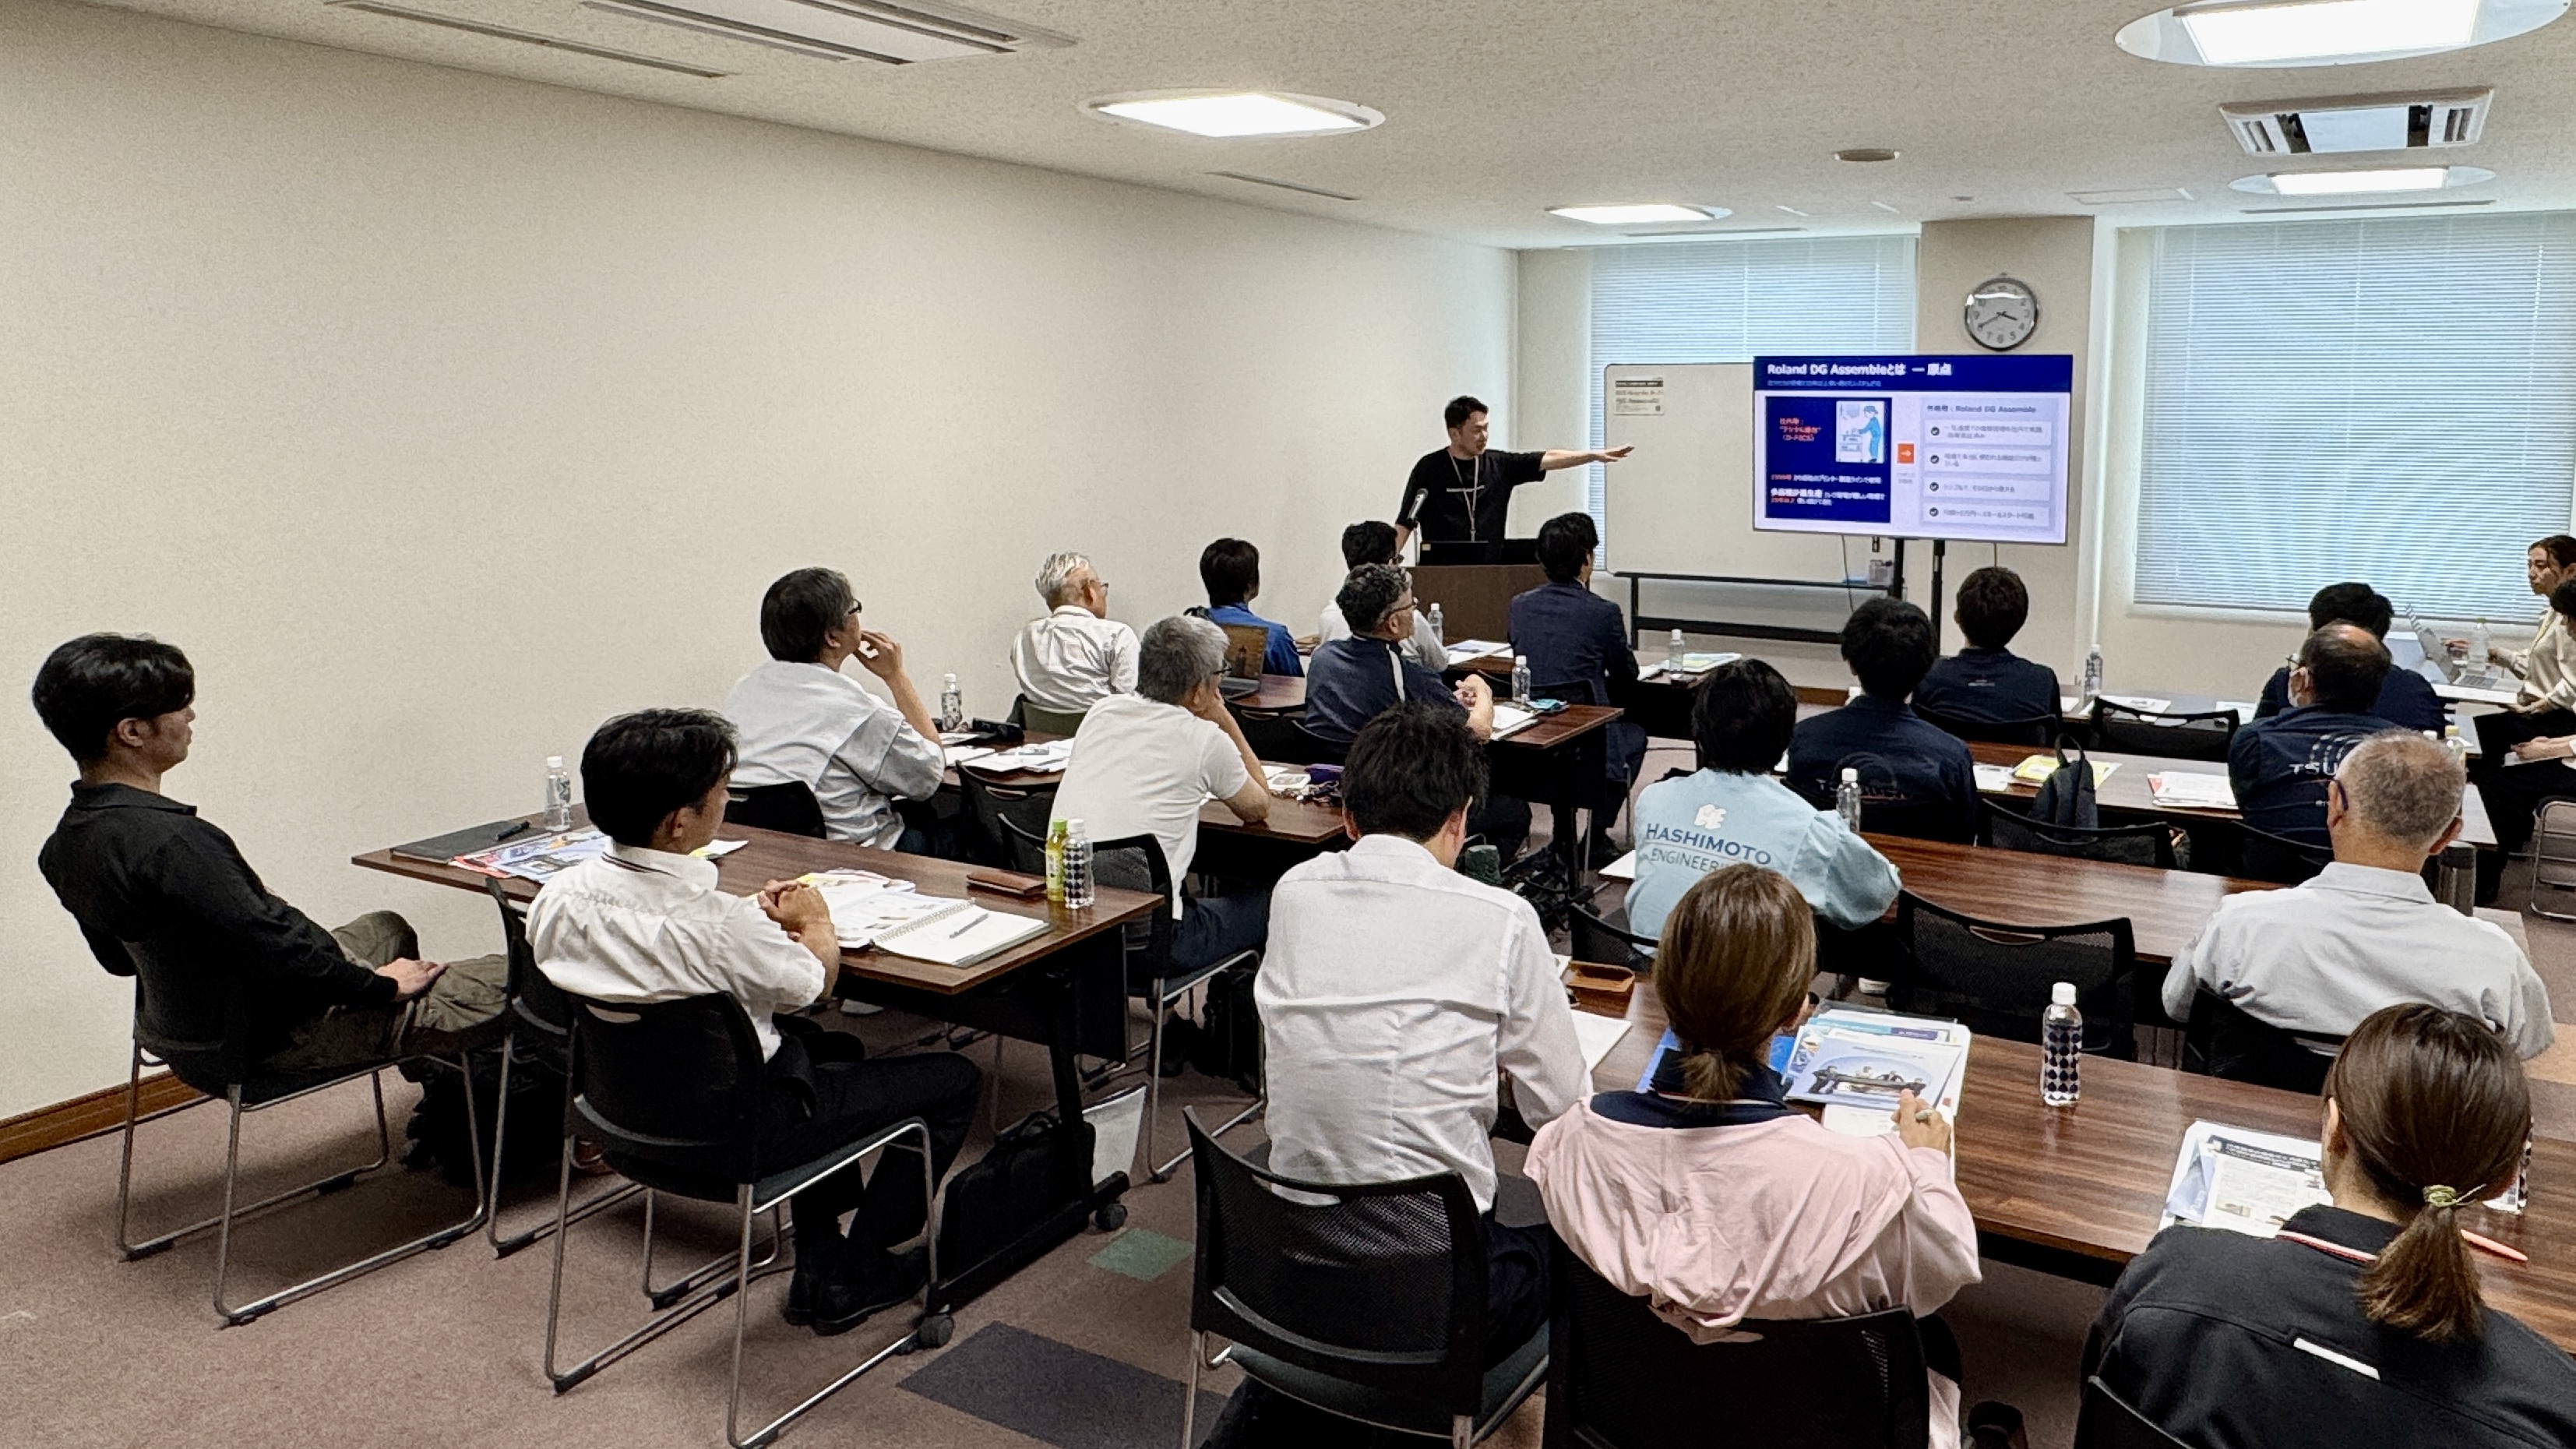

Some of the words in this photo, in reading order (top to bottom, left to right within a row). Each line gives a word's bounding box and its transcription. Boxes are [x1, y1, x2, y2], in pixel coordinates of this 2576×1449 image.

[1767, 363, 1807, 375] Roland
[1810, 363, 1827, 375] DG
[1645, 823, 1771, 865] HASHIMOTO
